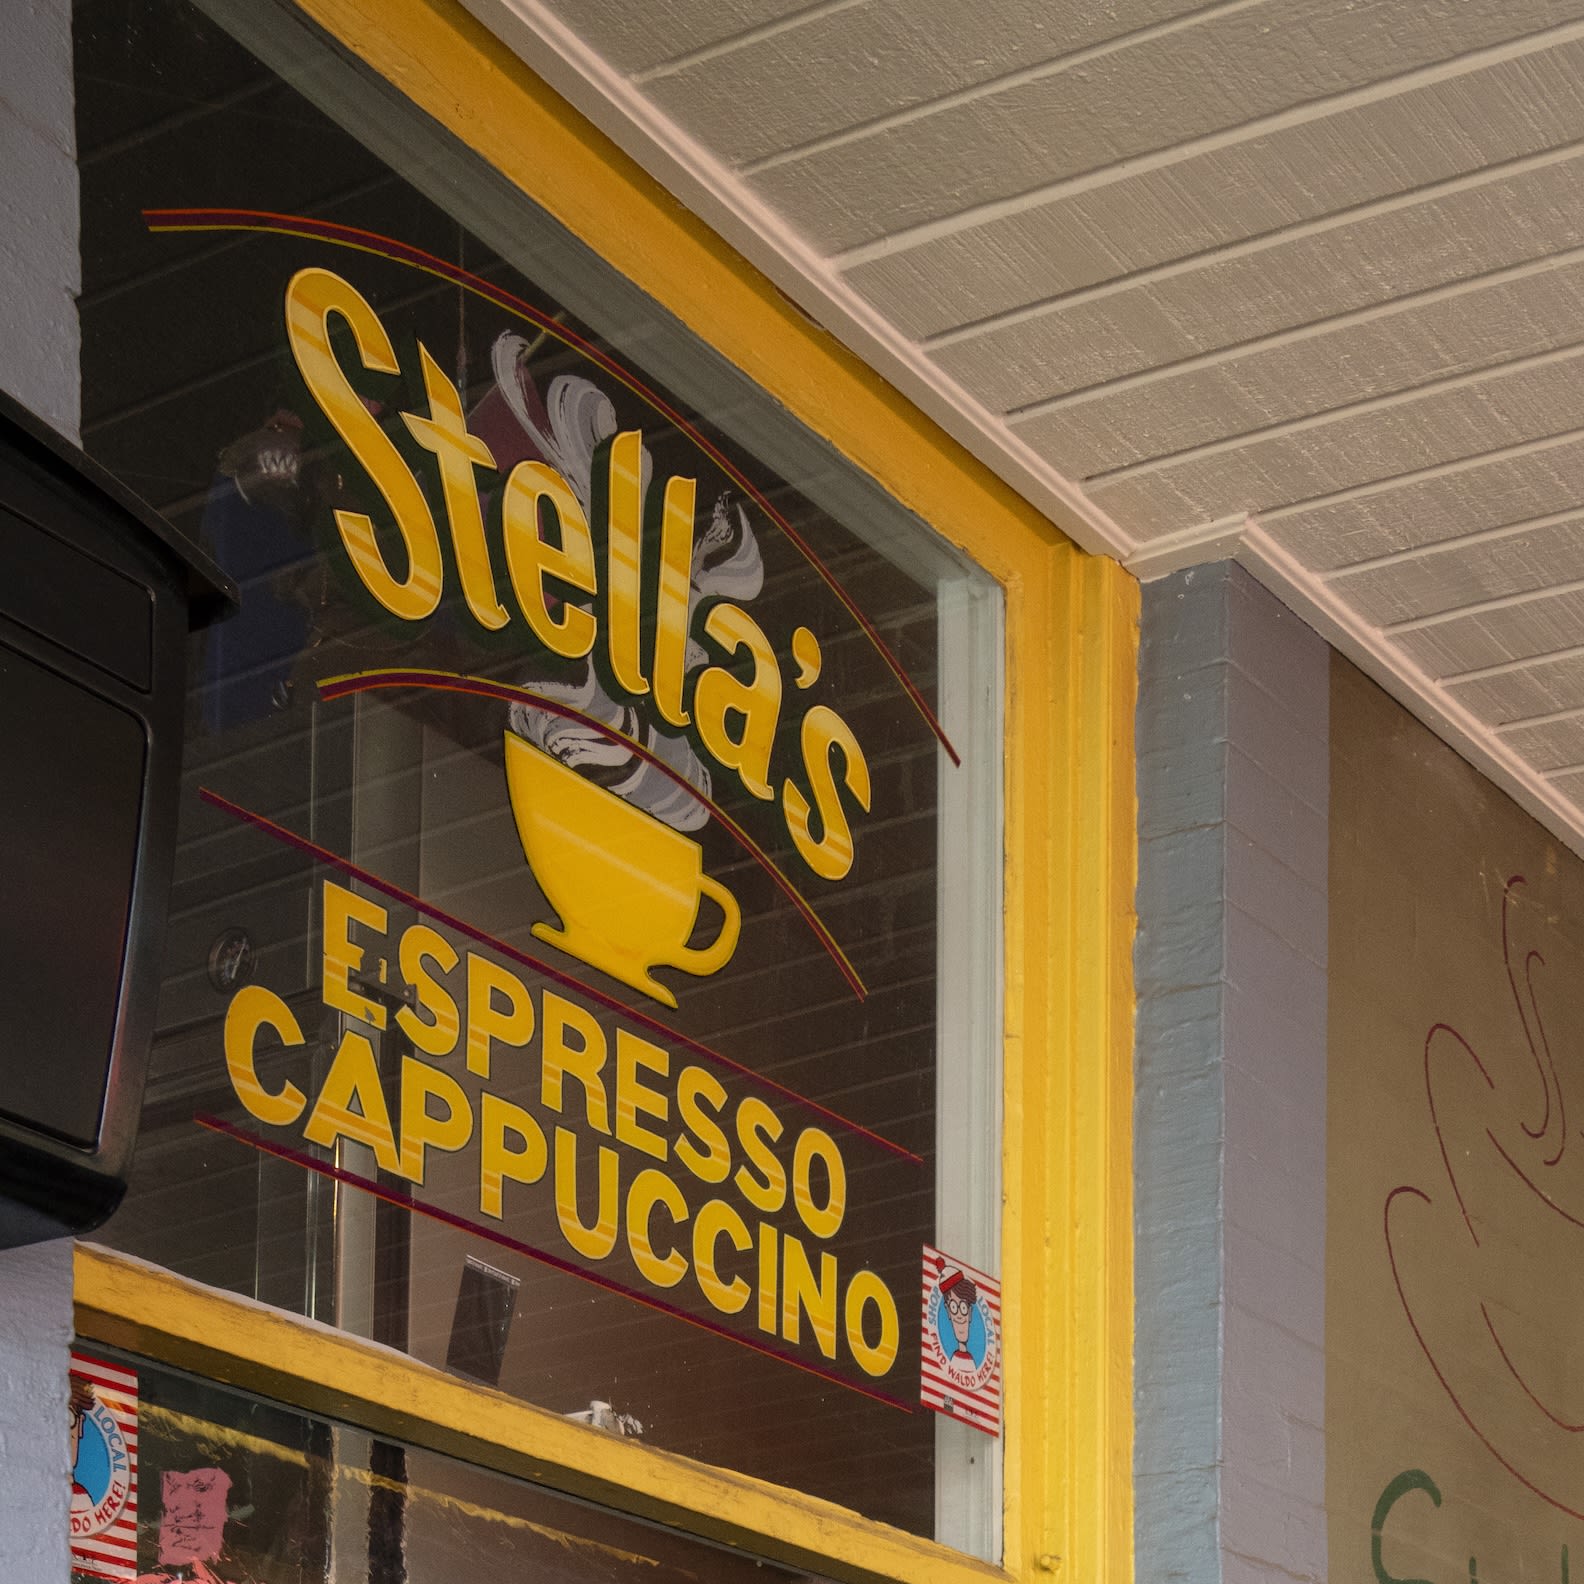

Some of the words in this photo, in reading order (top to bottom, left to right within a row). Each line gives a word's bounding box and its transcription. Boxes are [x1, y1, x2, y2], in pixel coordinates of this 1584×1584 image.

[285, 266, 872, 881] Stella's
[322, 878, 848, 1239] ESPRESSO
[223, 984, 900, 1377] CAPPUCCINO
[928, 1285, 941, 1326] SHOP
[977, 1296, 995, 1346] LOCAL
[930, 1331, 947, 1365] FIND
[947, 1364, 976, 1388] WALDO
[976, 1351, 994, 1382] HERE!
[93, 1405, 128, 1474] LOCAL
[94, 1479, 126, 1523] HERE!
